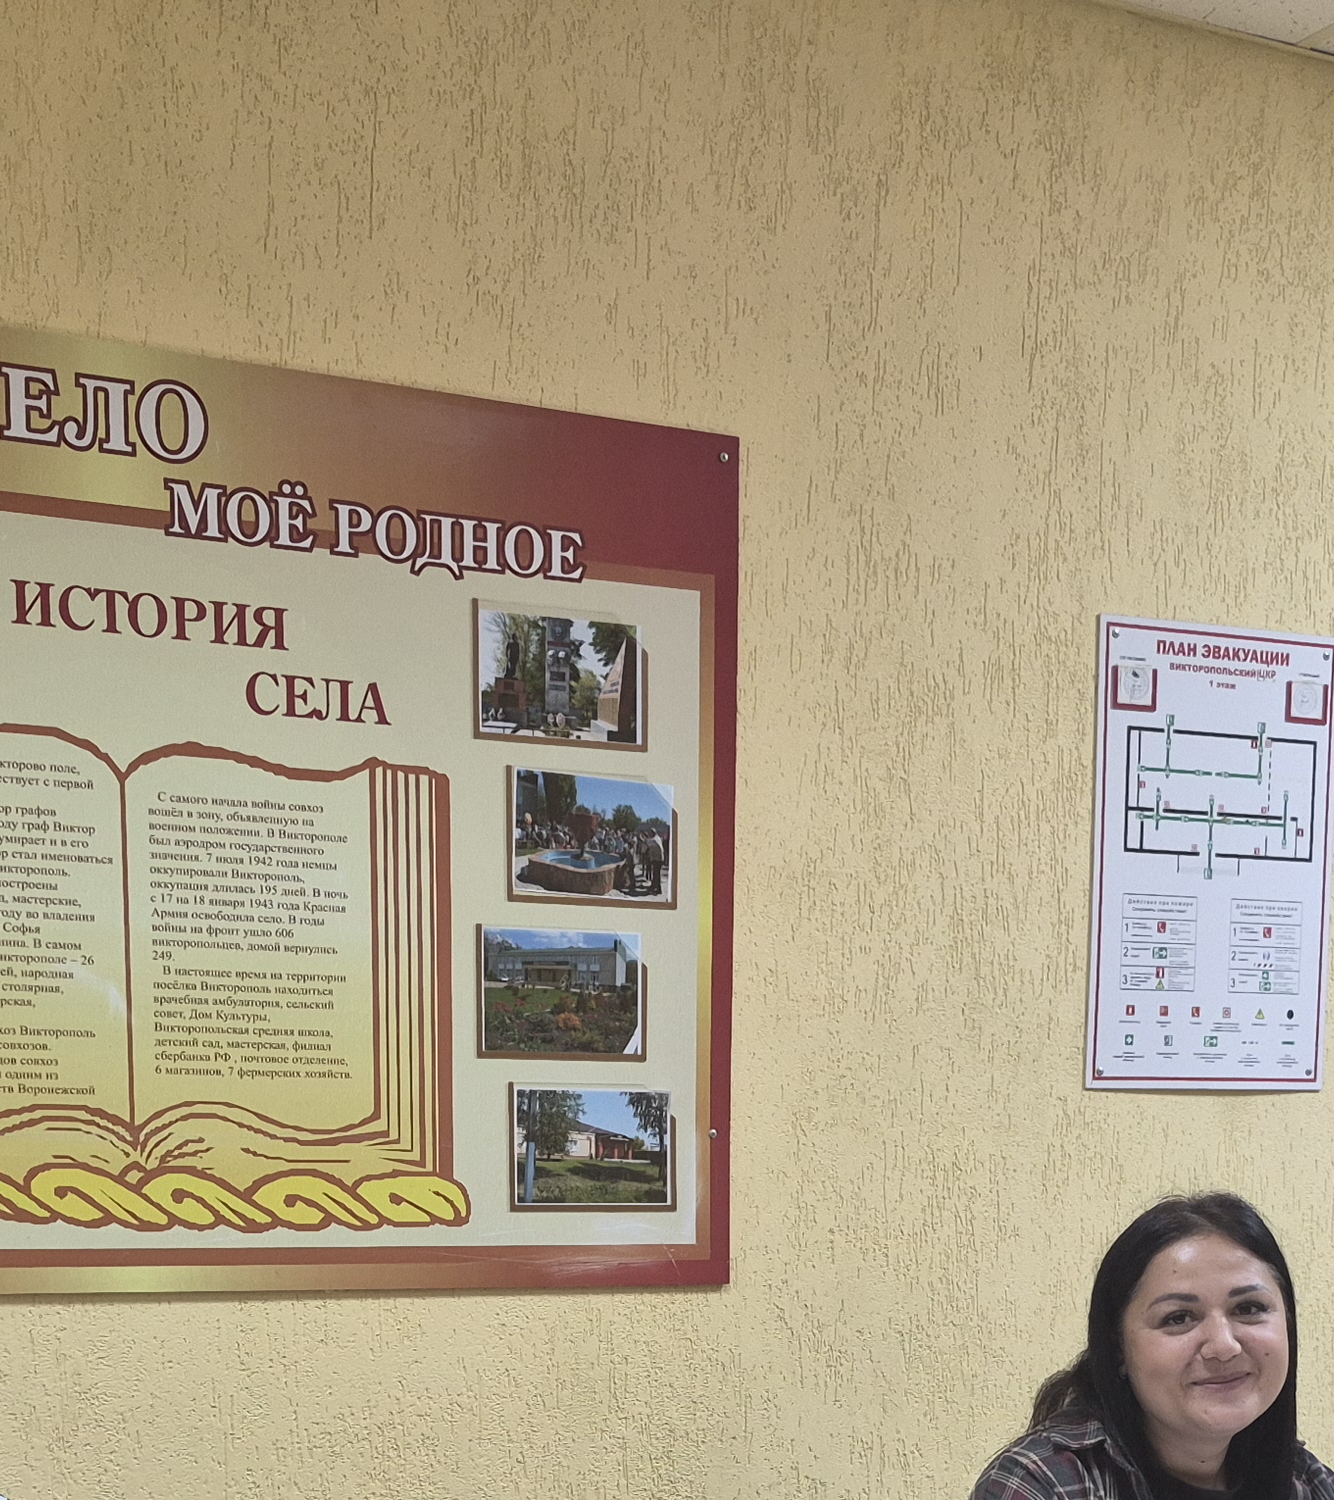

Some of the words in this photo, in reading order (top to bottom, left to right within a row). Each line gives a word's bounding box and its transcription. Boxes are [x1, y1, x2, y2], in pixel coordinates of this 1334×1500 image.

[164, 478, 316, 552] МОЁ
[329, 498, 585, 583] РОДНОЕ
[9, 579, 289, 650] ИСТОРИЯ
[1156, 639, 1197, 657] ПЛАН
[1201, 644, 1290, 666] ЭВАКУАЦИИ
[1169, 662, 1257, 678] ВИКТОРОПОЛЬСКИЙ
[245, 671, 392, 725] СЕЛА
[49, 764, 80, 776] поле,
[41, 778, 49, 788] с
[52, 778, 94, 791] первой
[14, 804, 57, 819] графов
[148, 822, 196, 834] военном
[266, 827, 275, 838] В
[278, 827, 347, 844] Викторополе
[148, 834, 171, 846] был
[174, 838, 226, 852] аэродром
[229, 841, 324, 856] государственного
[10, 850, 37, 860] стал
[40, 852, 113, 864] именоваться
[149, 866, 228, 879] оккупировали
[230, 867, 305, 884] Викторополь,
[11, 894, 81, 908] мастерские,
[2, 921, 40, 936] Софья
[151, 938, 244, 953] викторопольцев,
[245, 940, 280, 952] домой
[1123, 947, 1129, 957] 2
[151, 949, 175, 962] 249.
[1231, 951, 1237, 961] 2
[20, 969, 74, 981] народная
[1122, 975, 1128, 985] 3
[1, 983, 64, 996] столярная,
[152, 979, 197, 991] посёлка
[200, 980, 272, 996] Викторополь
[1230, 978, 1236, 988] 3
[152, 993, 210, 1007] врачебная
[285, 998, 334, 1010] сельский
[187, 1008, 213, 1020] Дом
[19, 1024, 96, 1040] Викторополь
[154, 1021, 249, 1036] Викторопольская
[252, 1027, 295, 1039] средняя
[297, 1028, 333, 1039] школа,
[153, 1036, 199, 1048] детский
[201, 1039, 223, 1050] сад,
[226, 1040, 289, 1052] мастерская,
[290, 1039, 331, 1053] филиал
[45, 1071, 58, 1080] из
[17, 1082, 95, 1097] Воронежской
